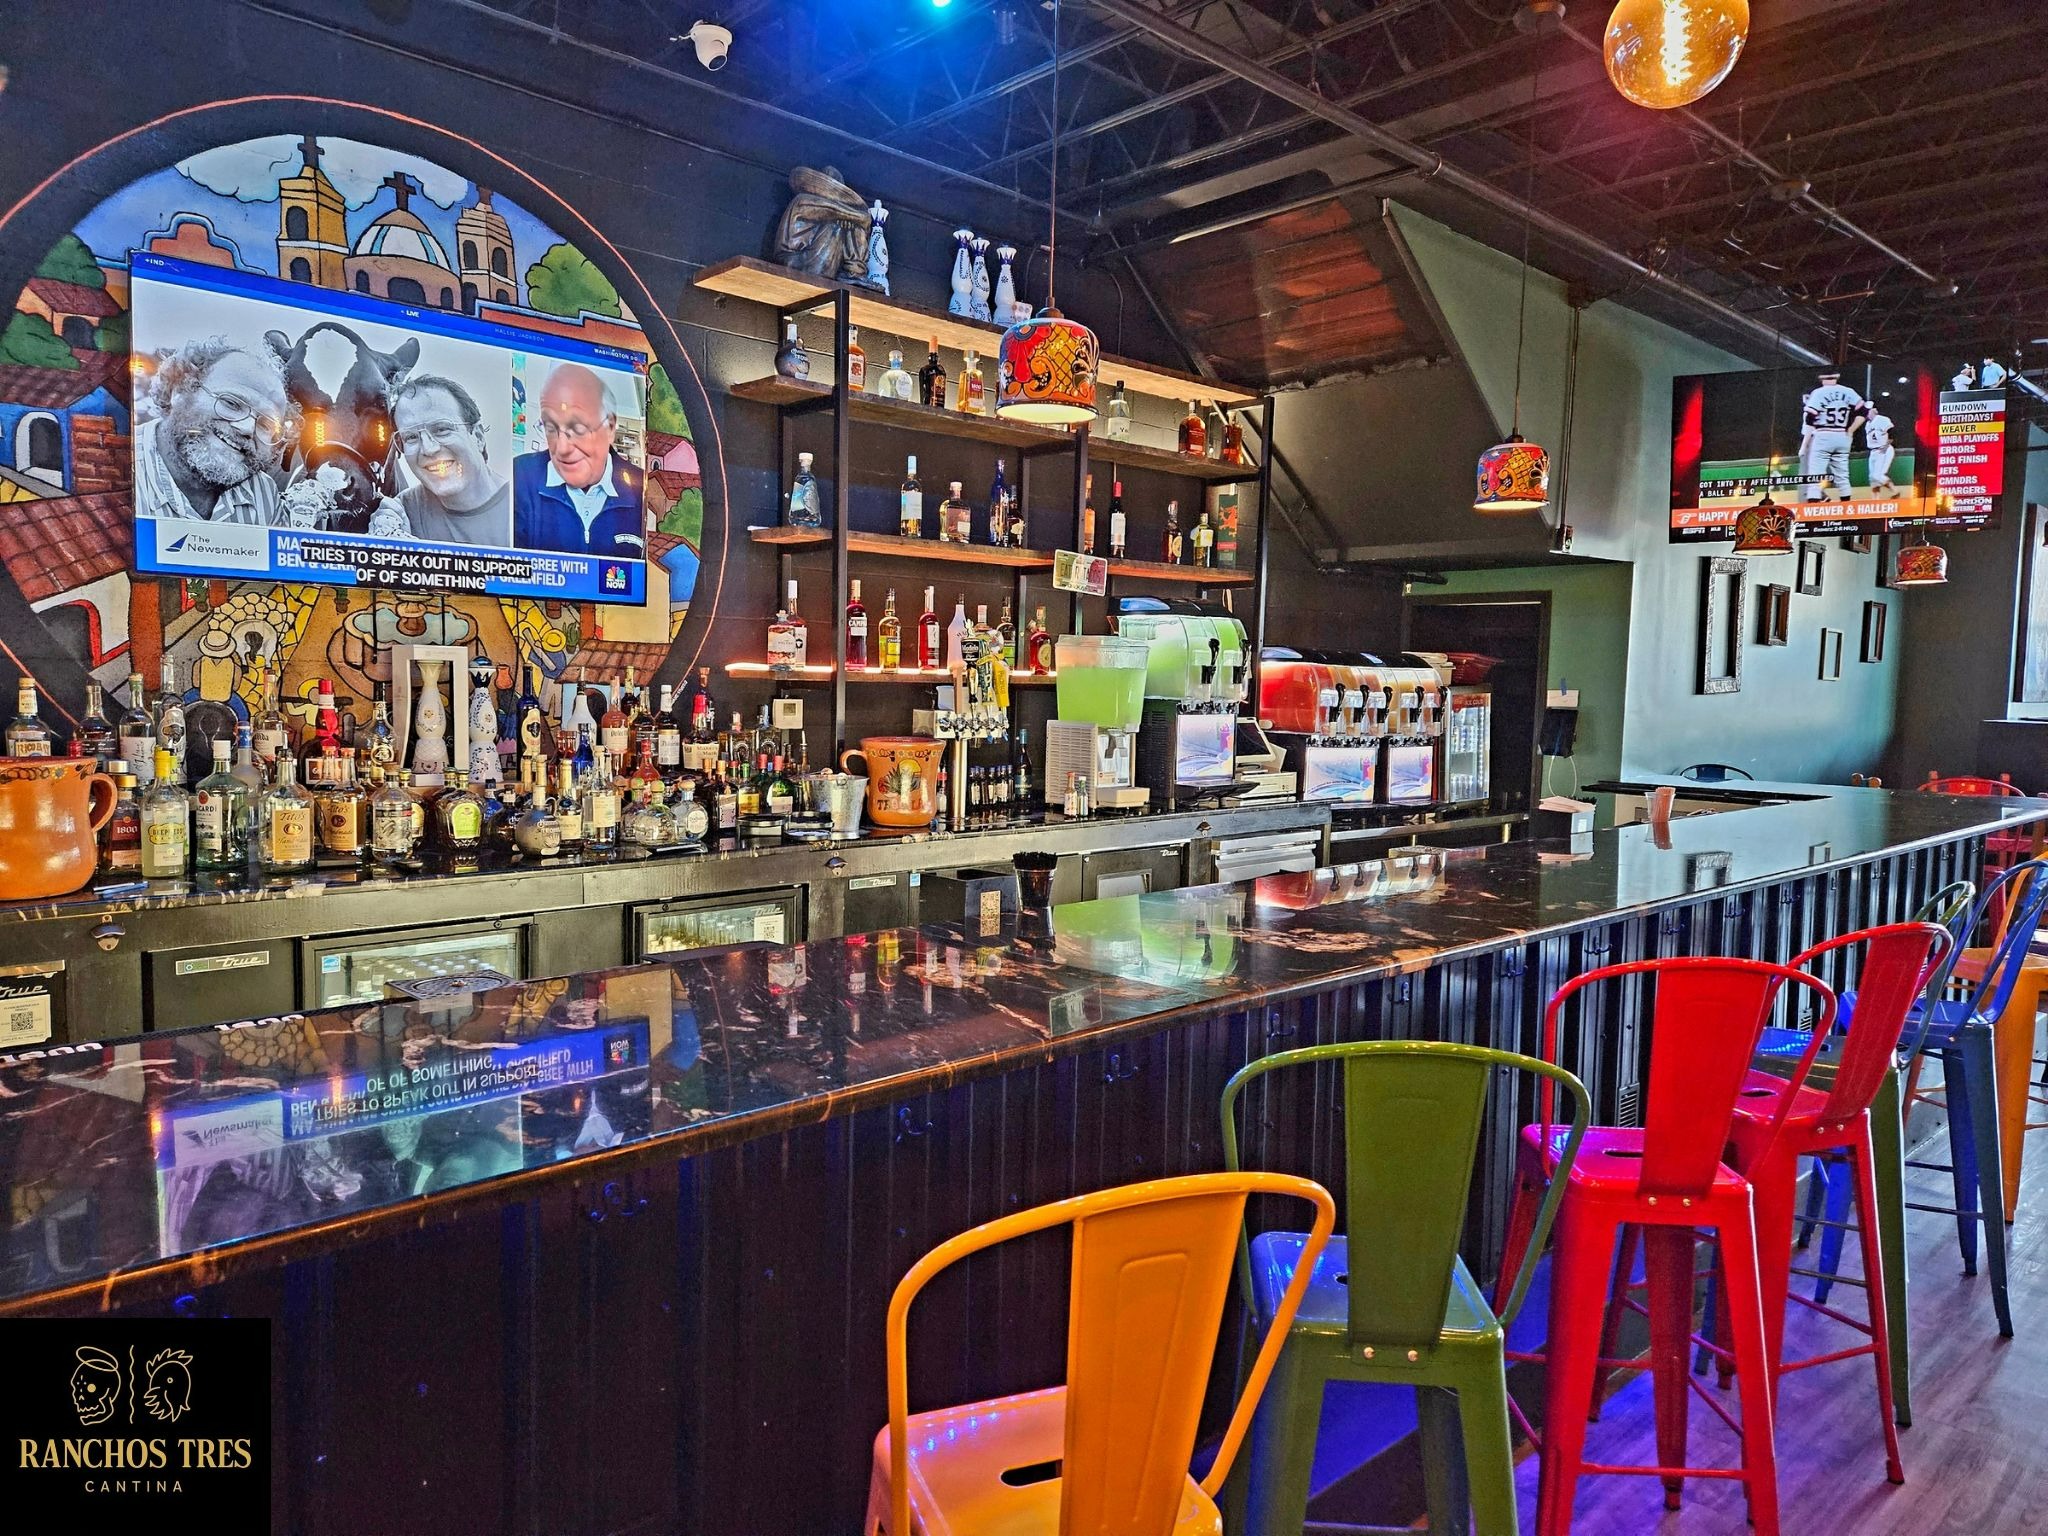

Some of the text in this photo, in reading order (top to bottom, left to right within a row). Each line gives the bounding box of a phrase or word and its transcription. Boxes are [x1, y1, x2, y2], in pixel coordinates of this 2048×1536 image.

[405, 309, 420, 318] LIVE
[1942, 402, 1987, 412] RUNDOWN
[1826, 407, 1847, 424] 53
[1941, 412, 1994, 424] BIRTHDAYS!
[1941, 424, 1977, 434] WEAVER
[1940, 433, 2000, 444] WNBA PLAYOFFS
[1940, 445, 1976, 455] ERRORS
[1939, 454, 1988, 465] BIG FINISH
[1938, 466, 1959, 475] JETS
[1699, 481, 1713, 489] GOT
[1717, 480, 1734, 488] INTO
[1737, 479, 1747, 487] IT
[1751, 478, 1773, 486] AFTER
[1806, 474, 1834, 483] CALLED
[1938, 475, 1978, 485] CMNDRS
[1707, 489, 1725, 497] BALL
[1938, 485, 1987, 495] CHARGERS
[1950, 496, 1993, 506] PARDON
[1803, 502, 1899, 518] WEAVER & HALLER!
[1950, 504, 1992, 512] INTERRUION
[1698, 510, 1730, 522] HAPPY
[191, 534, 211, 544] The
[186, 542, 260, 557] Newsmaker
[301, 546, 345, 562] TRIES
[347, 549, 369, 564] TO
[371, 552, 419, 568] SPEAK
[426, 557, 452, 570] OUT
[454, 559, 469, 573] IN
[471, 560, 532, 577] SUPPORT
[560, 559, 589, 574] WITH
[356, 568, 486, 590] OF OF SOMETHING
[605, 581, 626, 590] NOW
[116, 825, 138, 834] 1800
